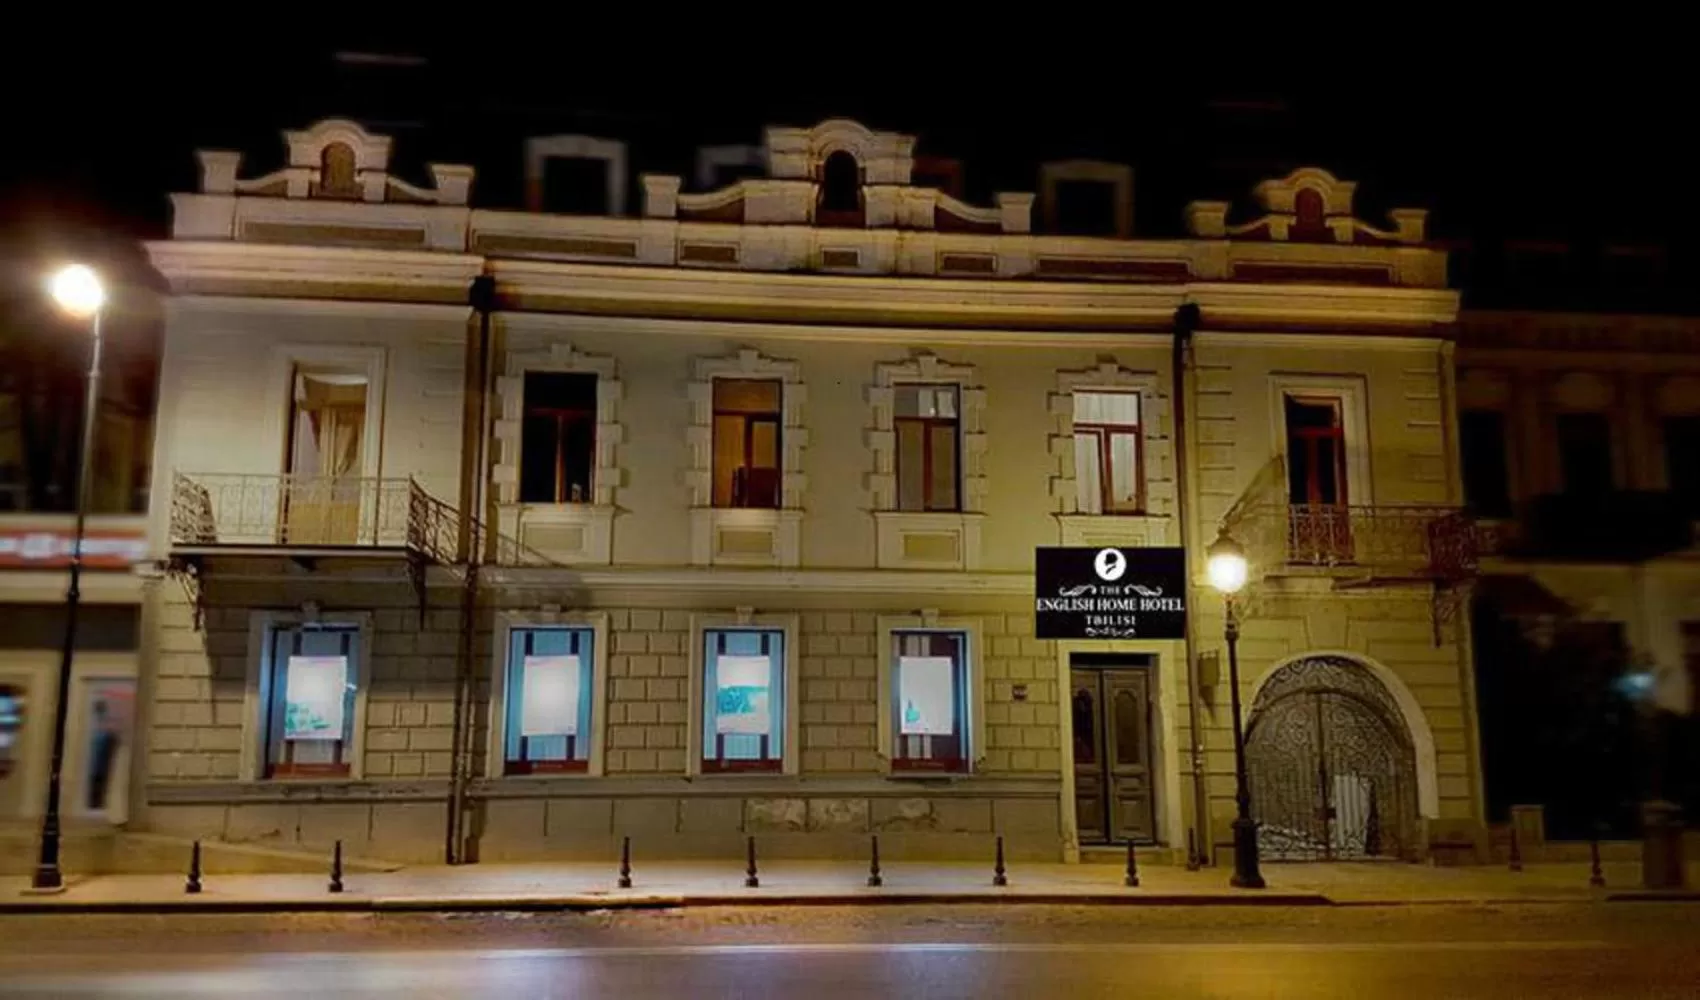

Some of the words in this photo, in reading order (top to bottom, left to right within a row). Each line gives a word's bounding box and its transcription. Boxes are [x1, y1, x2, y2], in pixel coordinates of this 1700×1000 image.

[1100, 585, 1121, 595] THE
[1036, 598, 1095, 612] ENGLISH
[1097, 598, 1137, 612] HOME
[1140, 598, 1185, 612] HOTEL
[1086, 614, 1136, 626] TBILISI
